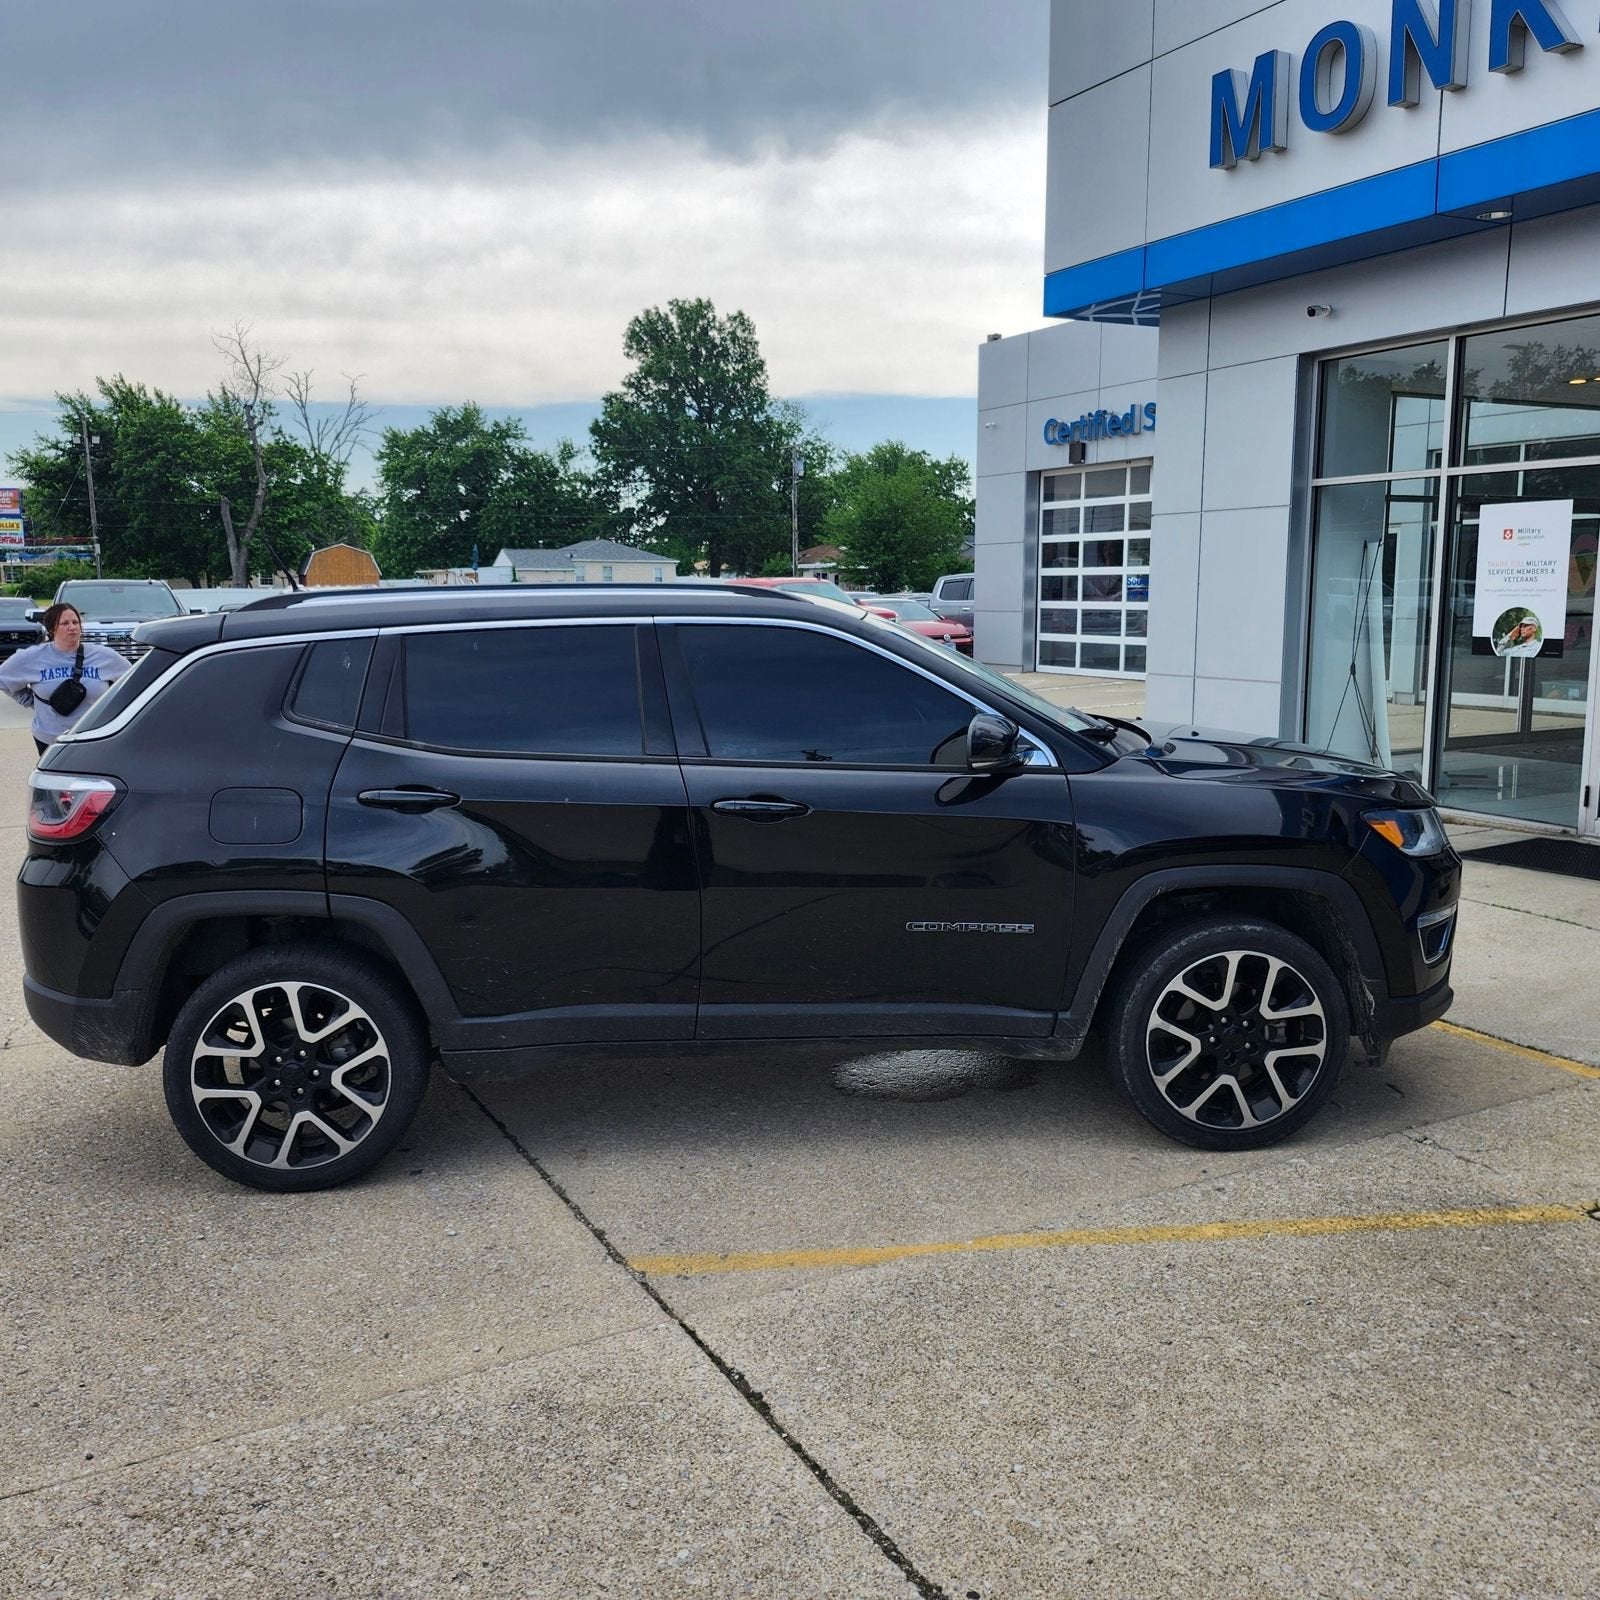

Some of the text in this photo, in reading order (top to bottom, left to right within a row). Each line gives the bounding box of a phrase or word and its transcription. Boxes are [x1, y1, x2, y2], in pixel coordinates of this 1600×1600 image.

[1210, 0, 1600, 170] MONK
[1043, 404, 1141, 446] Certified
[40, 666, 102, 681] KASKAKIA
[905, 921, 1035, 934] COMPASS
